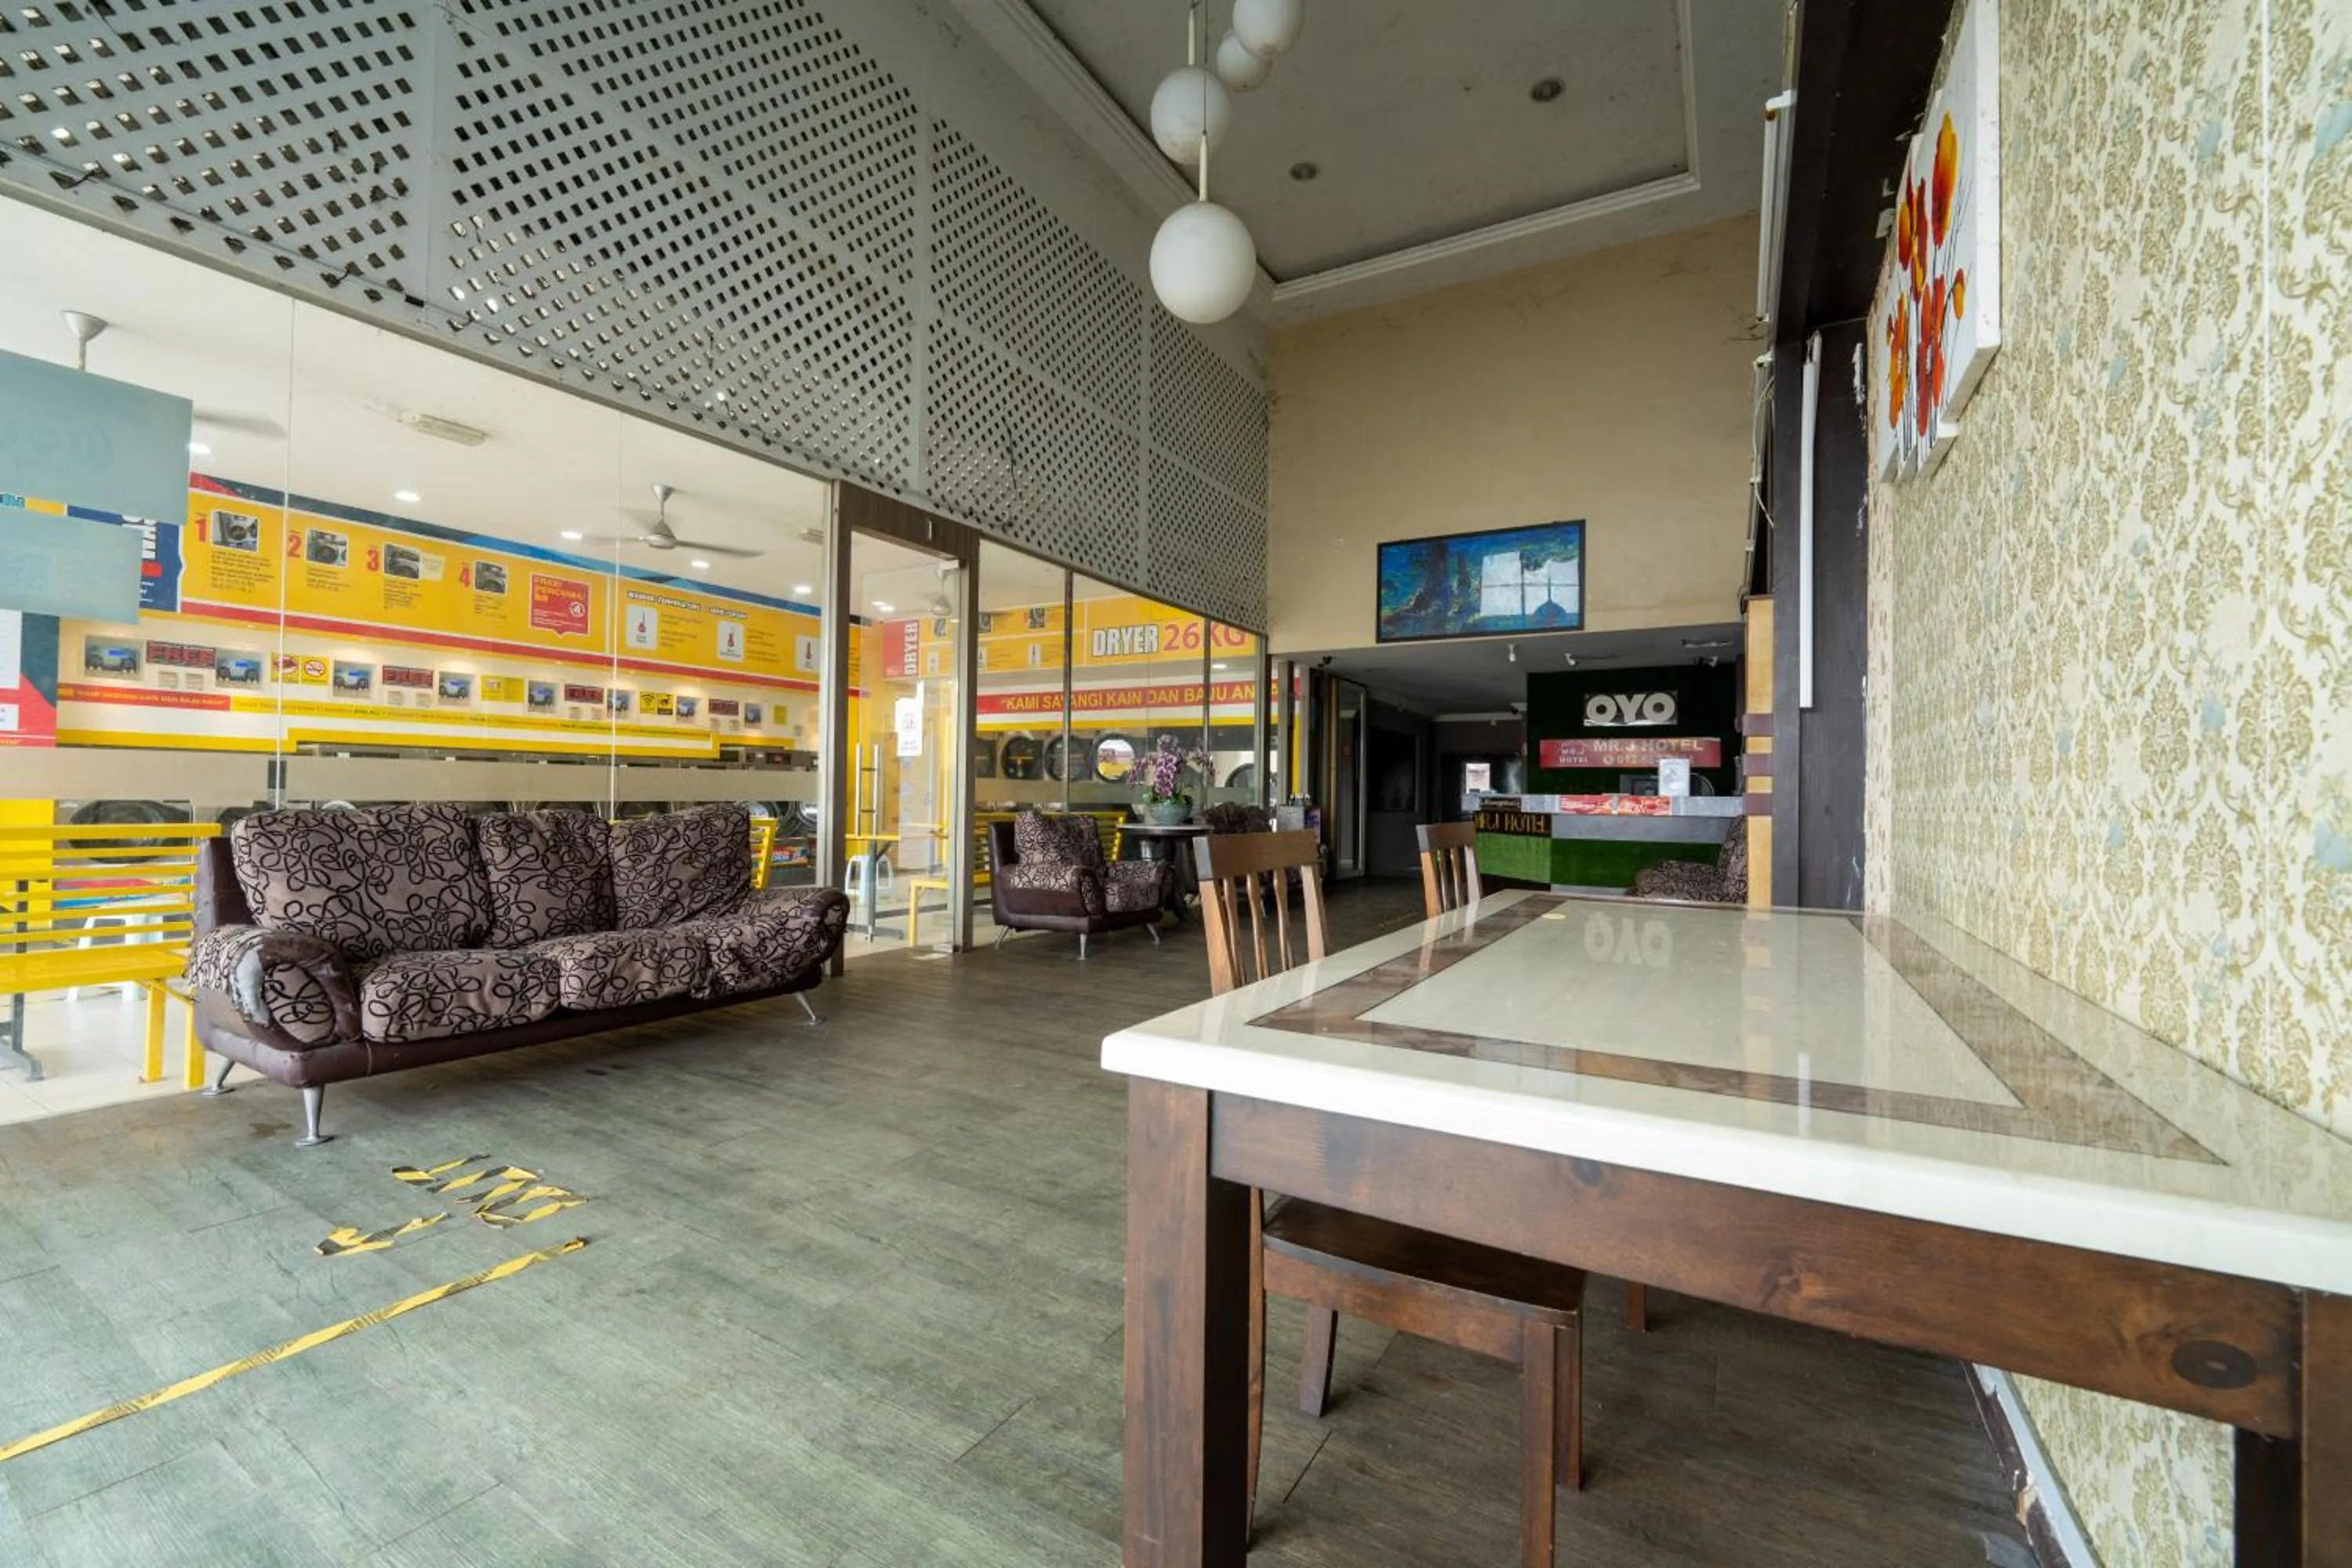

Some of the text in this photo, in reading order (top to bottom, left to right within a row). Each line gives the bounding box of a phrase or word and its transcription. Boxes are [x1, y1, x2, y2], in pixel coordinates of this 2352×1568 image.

[194, 515, 207, 543] 1
[288, 535, 302, 558] 2
[367, 549, 379, 572] 3
[459, 565, 471, 588] 4
[904, 621, 918, 677] DRYER
[1092, 625, 1159, 657] DRYER
[1106, 691, 1142, 706] KAIN
[1147, 688, 1179, 704] DAN
[1184, 686, 1227, 703] BAJU
[1586, 691, 1676, 724] OYO
[1642, 739, 1704, 752] HOTEL
